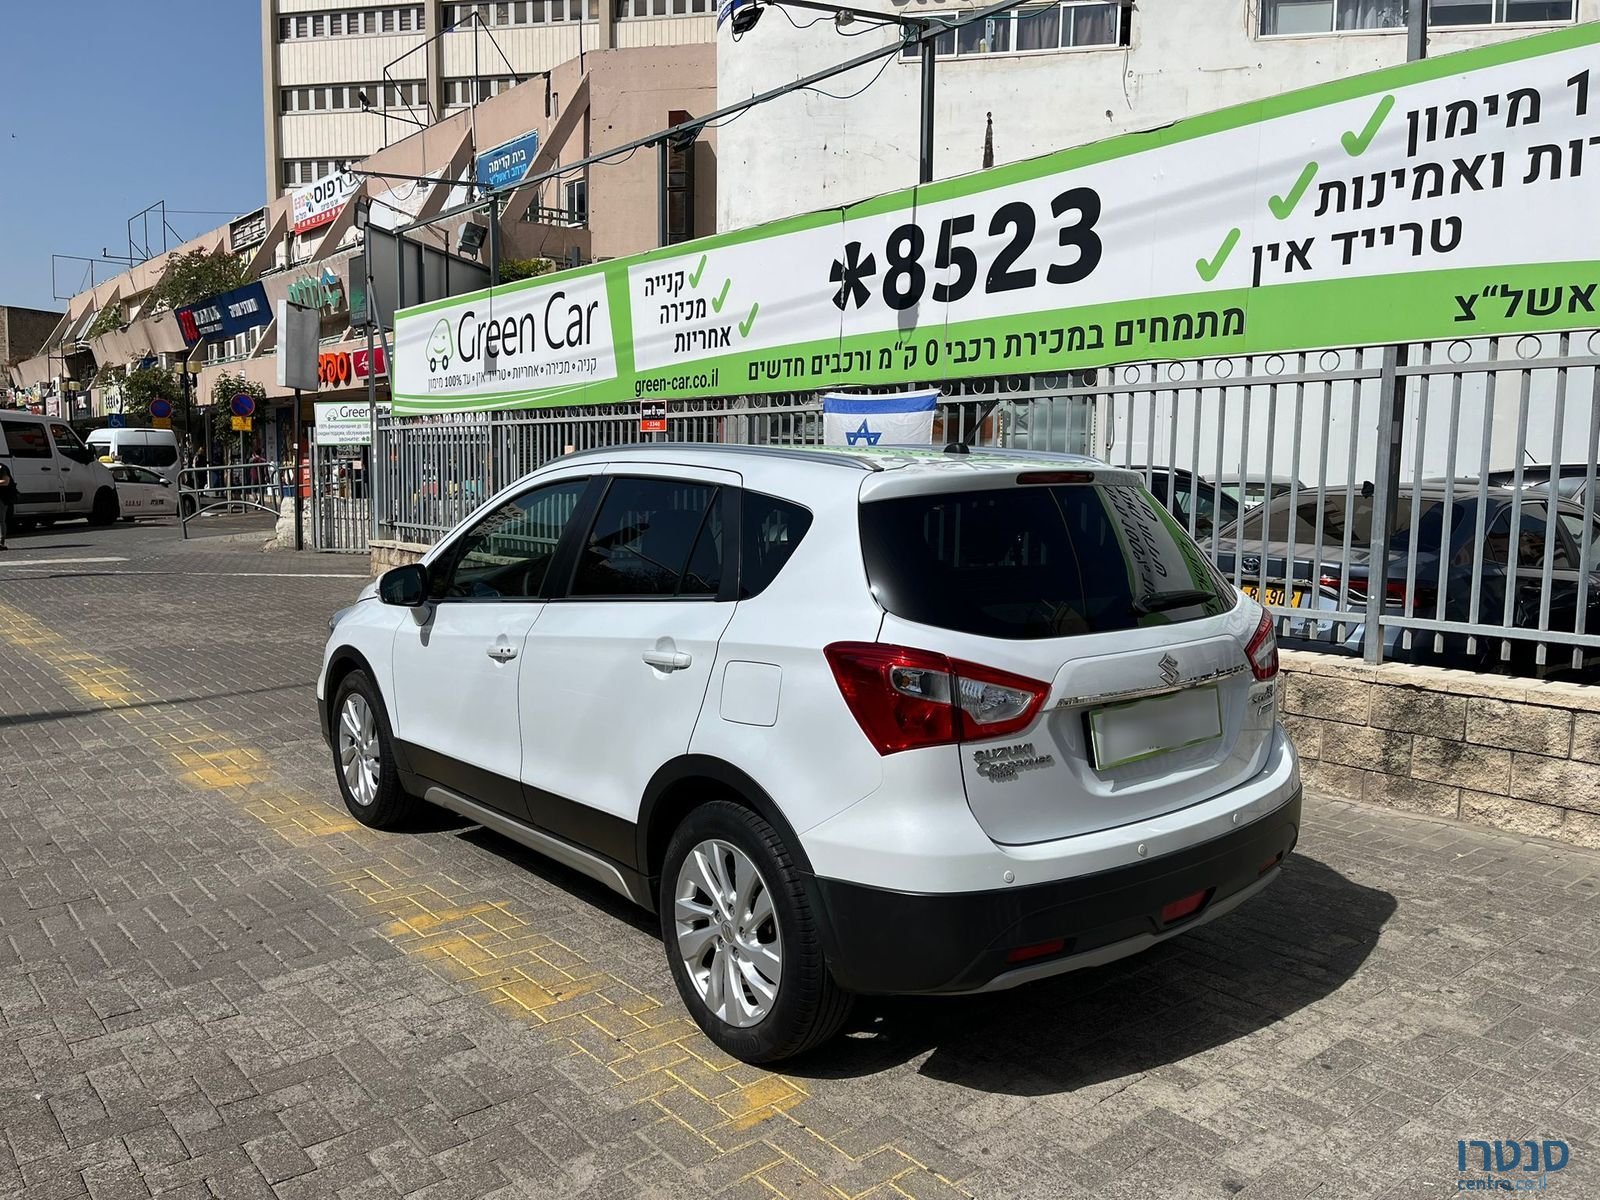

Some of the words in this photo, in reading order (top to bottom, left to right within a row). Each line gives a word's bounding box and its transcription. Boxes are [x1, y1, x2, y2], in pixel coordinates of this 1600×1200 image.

[1406, 87, 1541, 157] מימון
[512, 149, 526, 164] בית
[1314, 151, 1505, 217] ואמינות
[1331, 215, 1463, 266] טרייד
[1252, 237, 1315, 288] אין
[645, 271, 685, 298] קנייה
[660, 297, 707, 325] מכירה
[457, 311, 536, 362] Green
[544, 291, 599, 350] Car
[674, 326, 732, 353] אחריות
[1114, 308, 1245, 347] מתמחים
[925, 338, 939, 366] 0
[945, 336, 996, 364] רכבי
[1003, 323, 1105, 359] במכירת
[512, 364, 540, 380] אחריות
[545, 360, 570, 376] מכירה
[577, 358, 597, 375] קניה
[748, 357, 805, 381] חדשים
[811, 350, 872, 376] ורכבים
[444, 375, 462, 388] 100%
[635, 368, 719, 397] green-car.co.il
[973, 743, 1036, 764] SUZUKI
